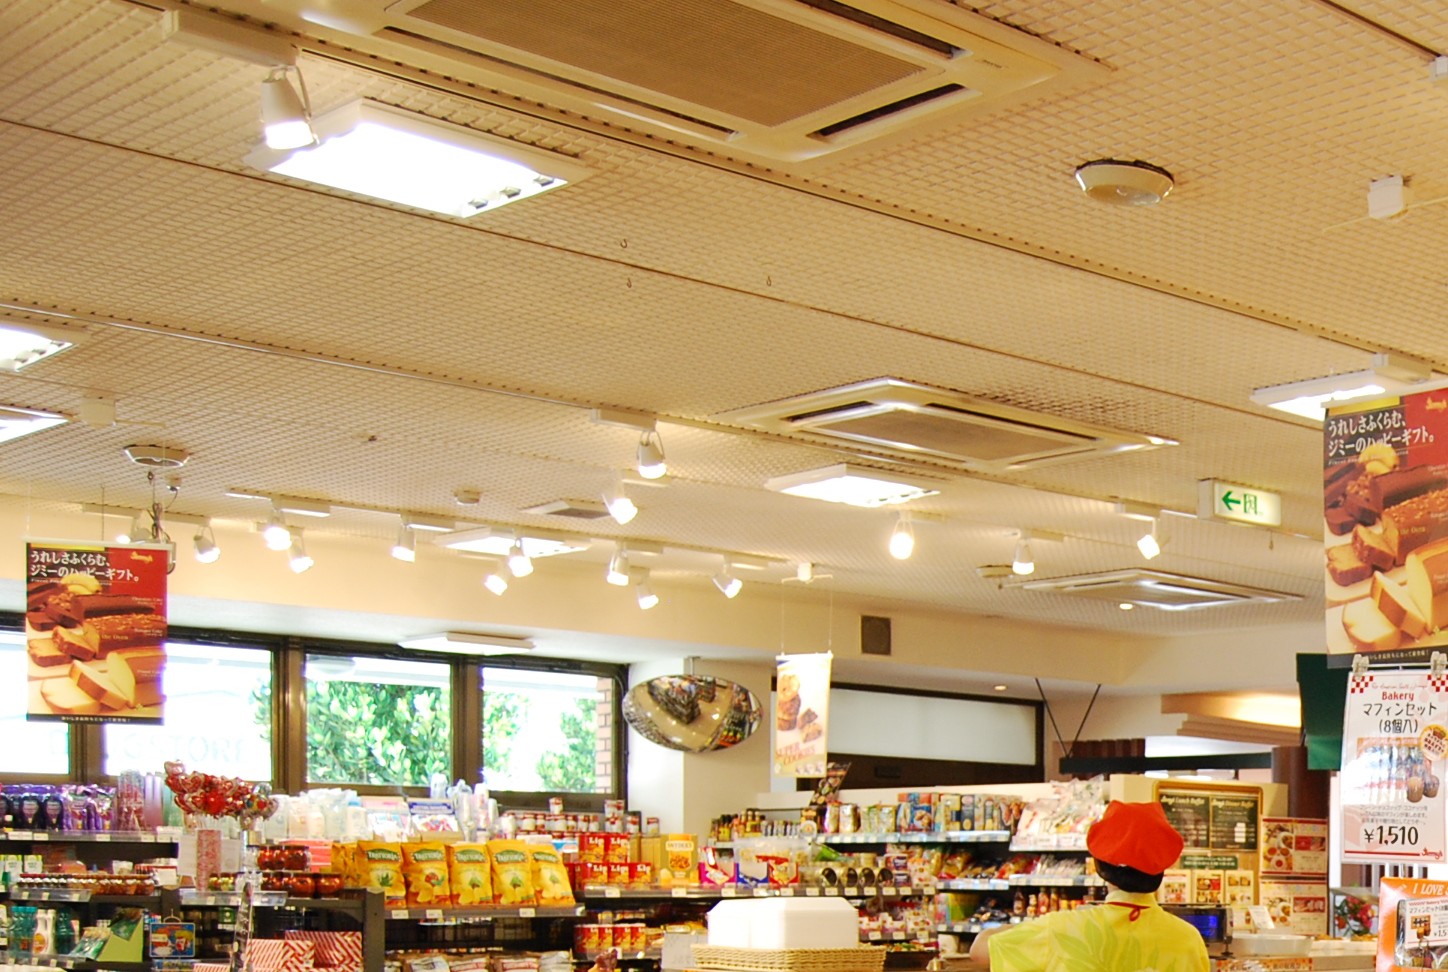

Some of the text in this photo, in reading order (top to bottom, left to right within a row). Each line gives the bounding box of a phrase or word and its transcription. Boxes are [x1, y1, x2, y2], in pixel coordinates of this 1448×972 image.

[1328, 410, 1406, 437] うれしさふくらむ、
[1328, 425, 1434, 457] ジミーのハッピーギフト。
[30, 551, 110, 567] うれしさふくらむ、
[30, 565, 139, 582] ジミーのハッピーギフト。
[1381, 691, 1415, 701] Bakery
[1363, 702, 1437, 716] マフィンセット
[1364, 826, 1419, 845] ¥1,510
[1413, 883, 1418, 894] I
[1421, 884, 1444, 895] LOVE
